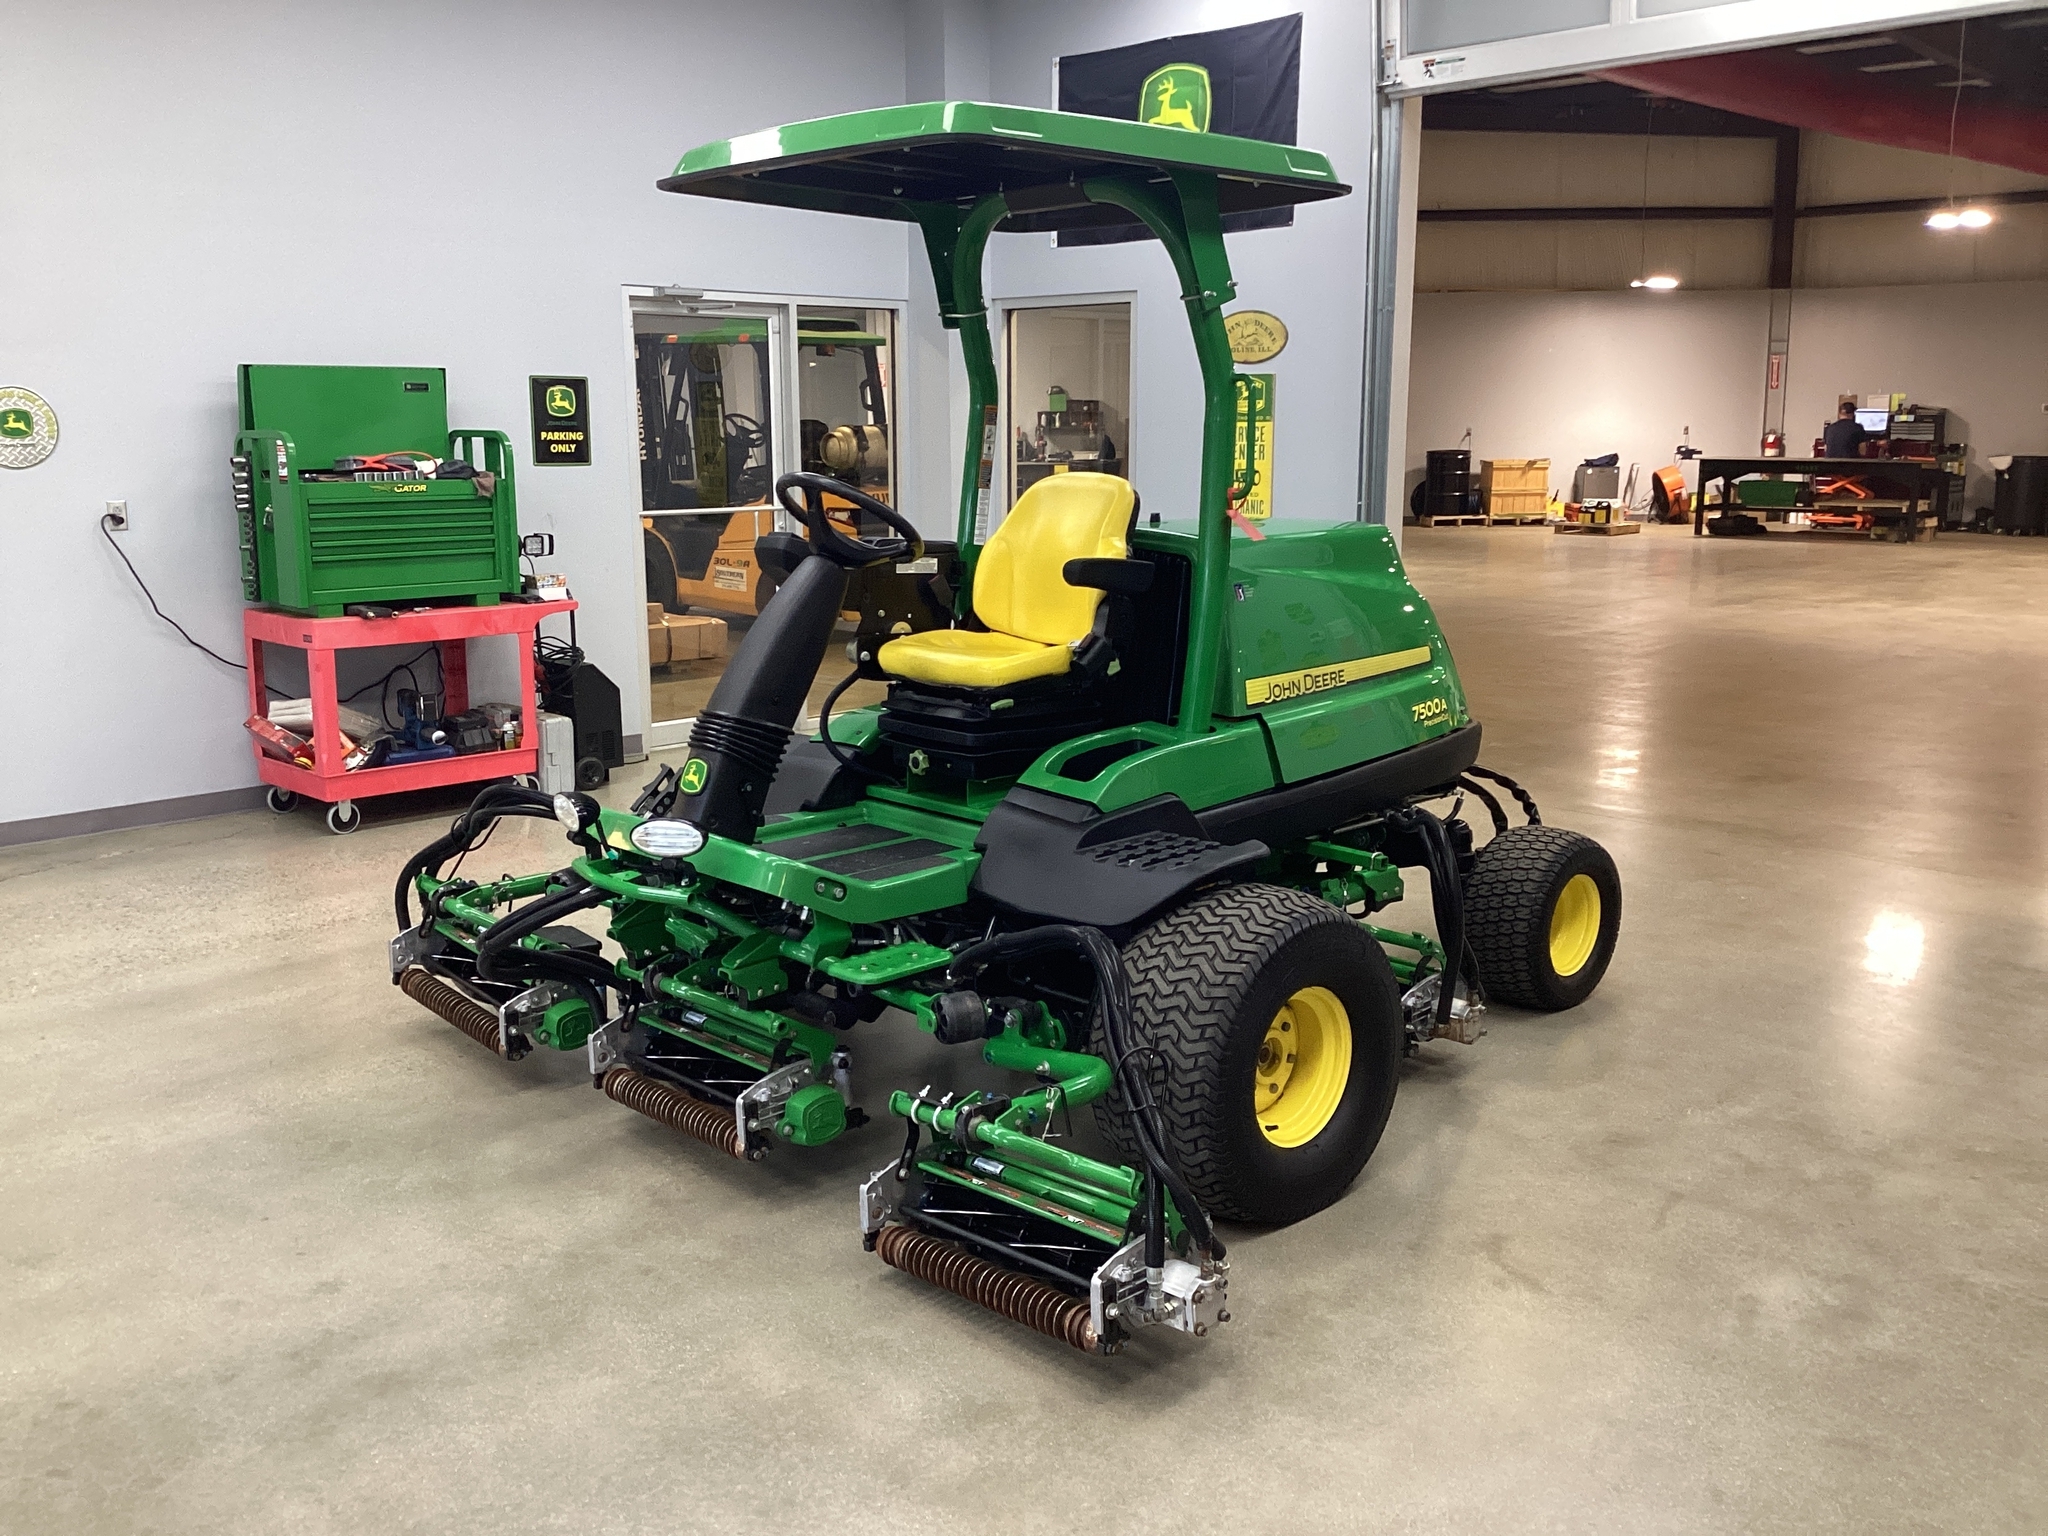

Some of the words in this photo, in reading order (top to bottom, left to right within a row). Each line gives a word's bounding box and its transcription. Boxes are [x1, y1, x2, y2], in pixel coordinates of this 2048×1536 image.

[540, 431, 584, 441] PARKING
[550, 443, 577, 453] ONLY
[394, 484, 427, 492] GATOR
[713, 557, 750, 568] 30L-9A
[1264, 678, 1302, 701] JOHN
[1303, 669, 1345, 692] DEERE
[1412, 698, 1447, 722] 7500A
